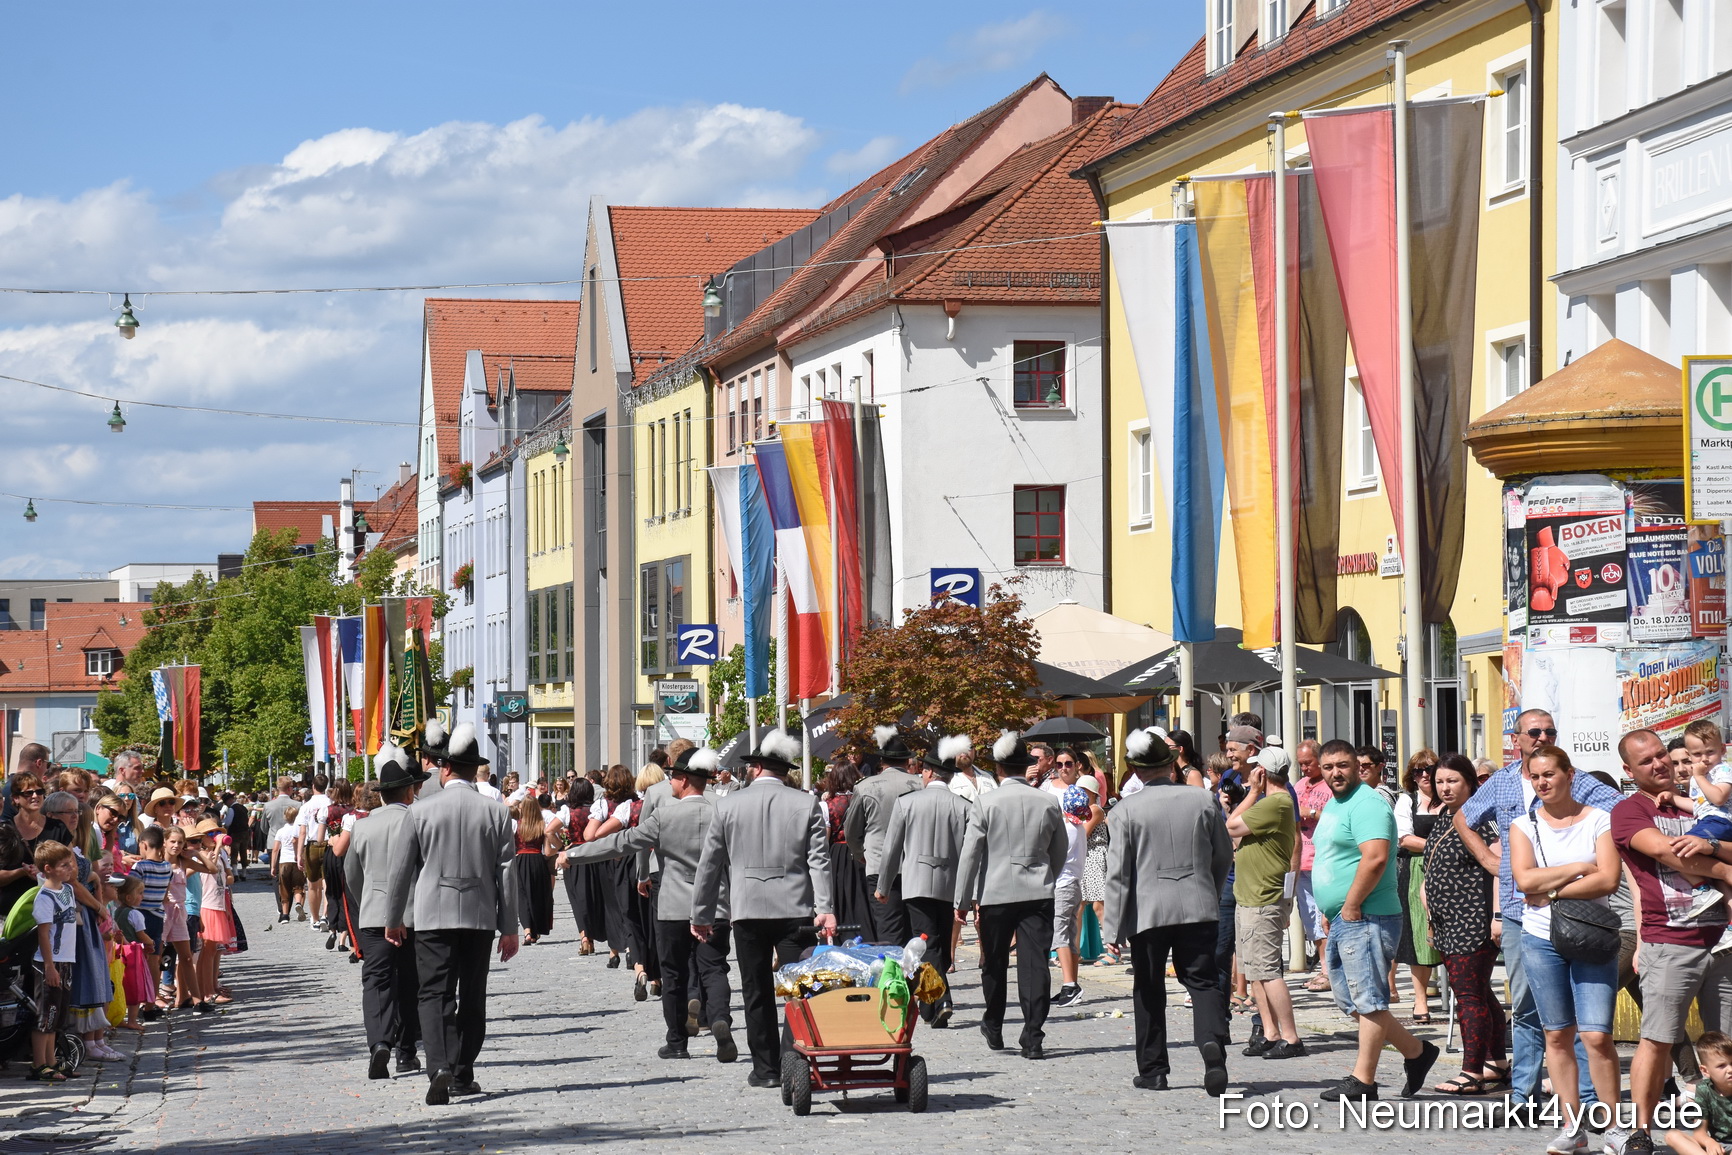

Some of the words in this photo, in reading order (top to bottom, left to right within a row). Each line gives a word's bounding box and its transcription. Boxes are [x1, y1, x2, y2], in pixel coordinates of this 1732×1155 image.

[1655, 145, 1722, 208] BRILLEN
[1561, 518, 1622, 541] BOXEN
[1603, 570, 1620, 580] FCN
[1639, 660, 1665, 680] Open
[1622, 655, 1718, 710] Kinosommer
[1670, 685, 1706, 706] August
[1644, 715, 1671, 727] Bohemian
[1572, 730, 1609, 742] FOKUS
[1573, 742, 1610, 753] FIGUR
